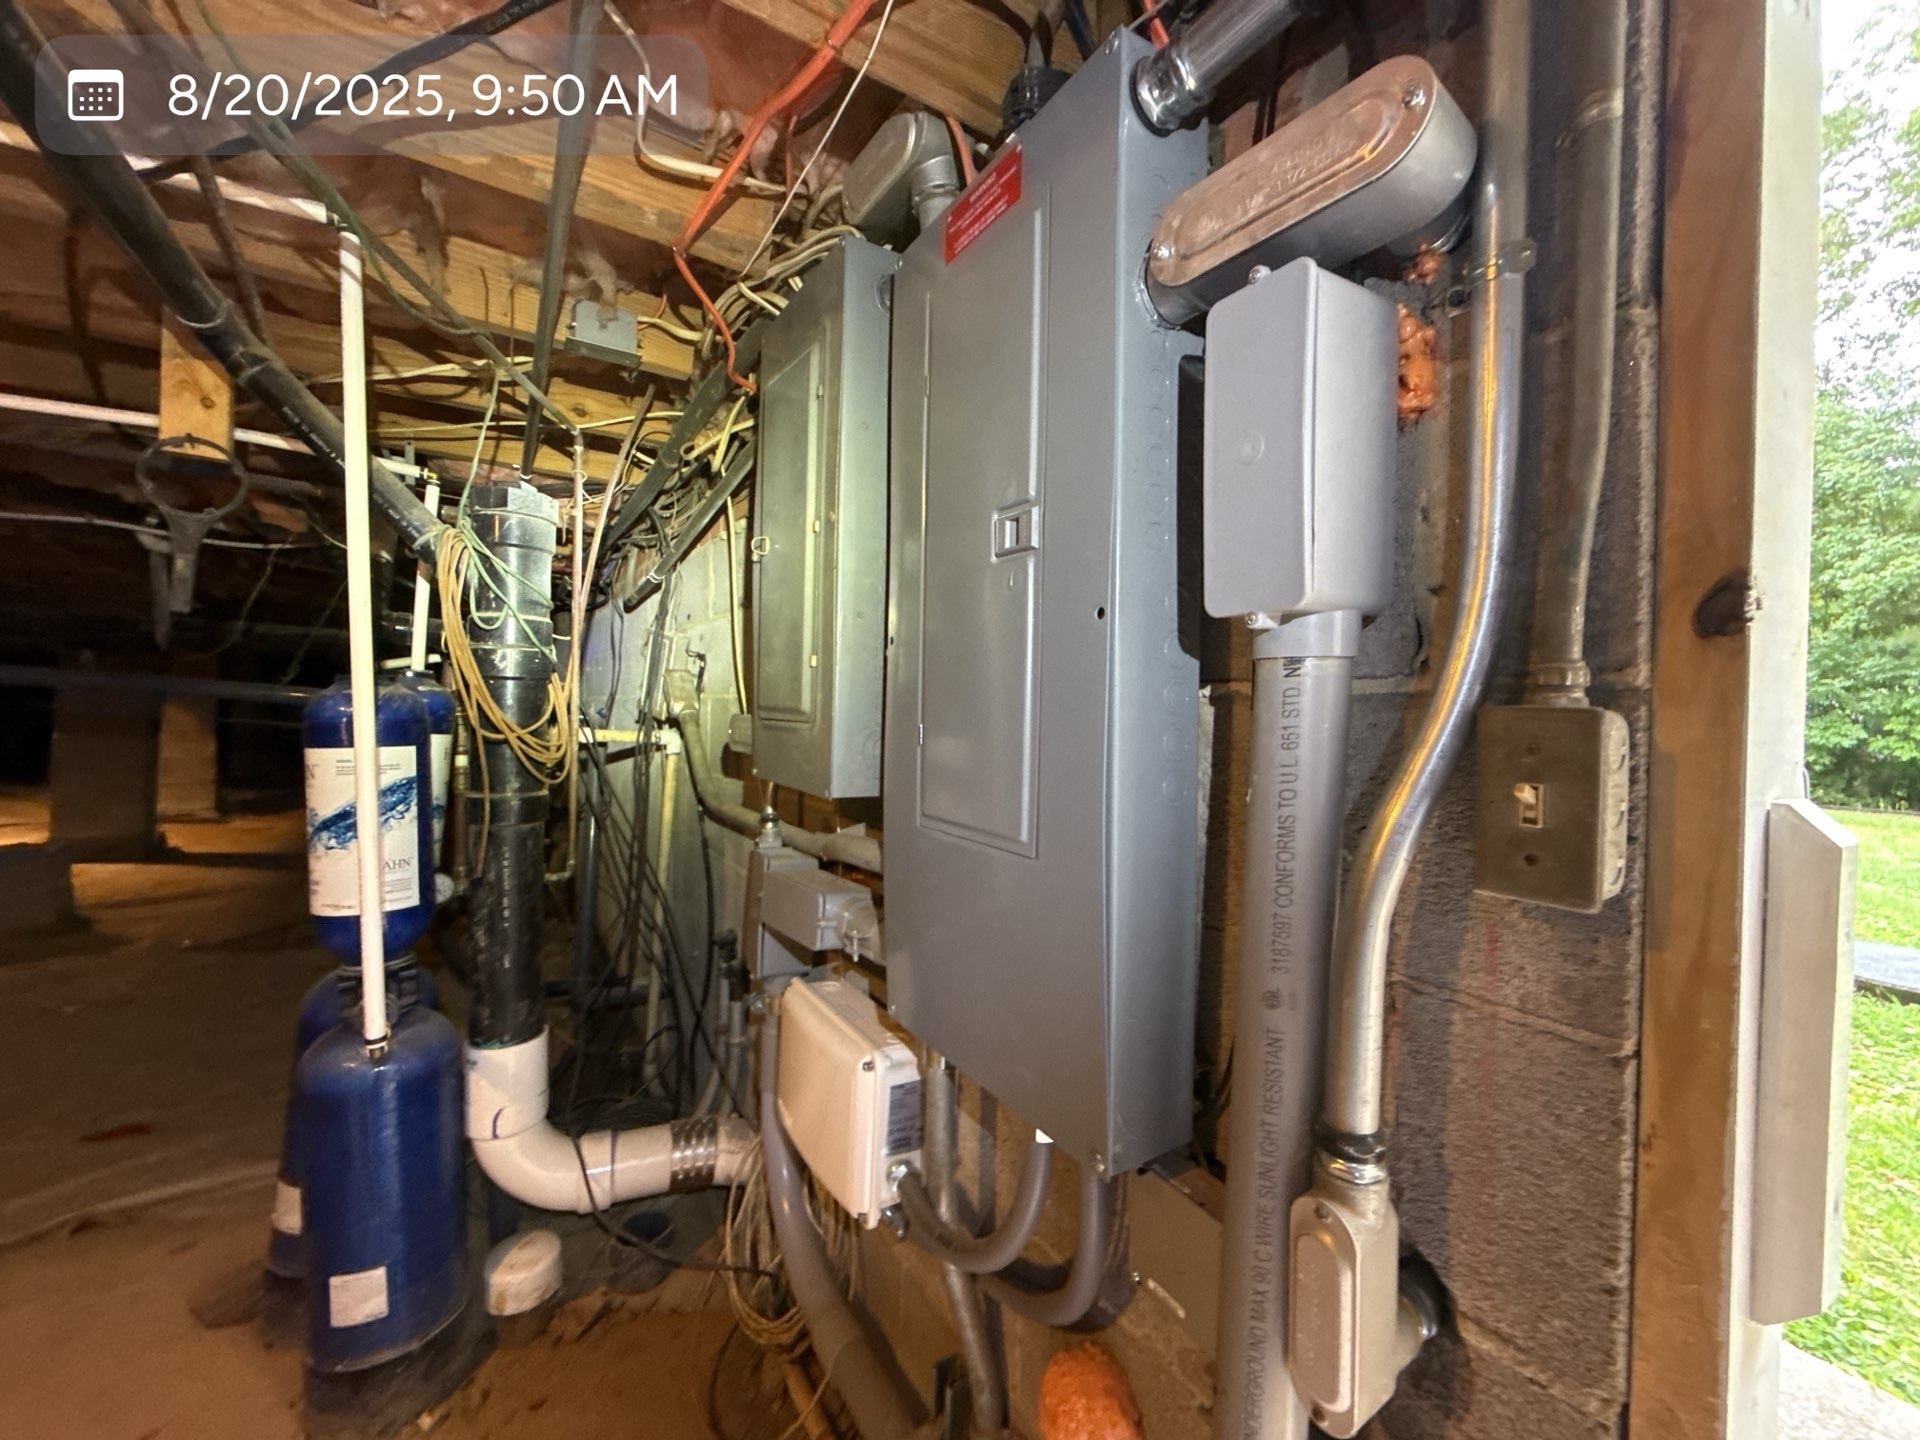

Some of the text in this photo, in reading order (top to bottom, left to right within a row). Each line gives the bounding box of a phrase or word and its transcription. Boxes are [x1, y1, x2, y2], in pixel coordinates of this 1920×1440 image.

[1280, 724, 1300, 751] 651
[1278, 788, 1297, 810] TO
[1273, 815, 1297, 908] CONFORMS
[1263, 1026, 1285, 1116] RESISTANT
[1257, 1119, 1280, 1199] SUNLIGHT
[1255, 1204, 1275, 1246] WIRE
[1253, 1249, 1273, 1262] C
[1249, 1287, 1270, 1323] MAX
